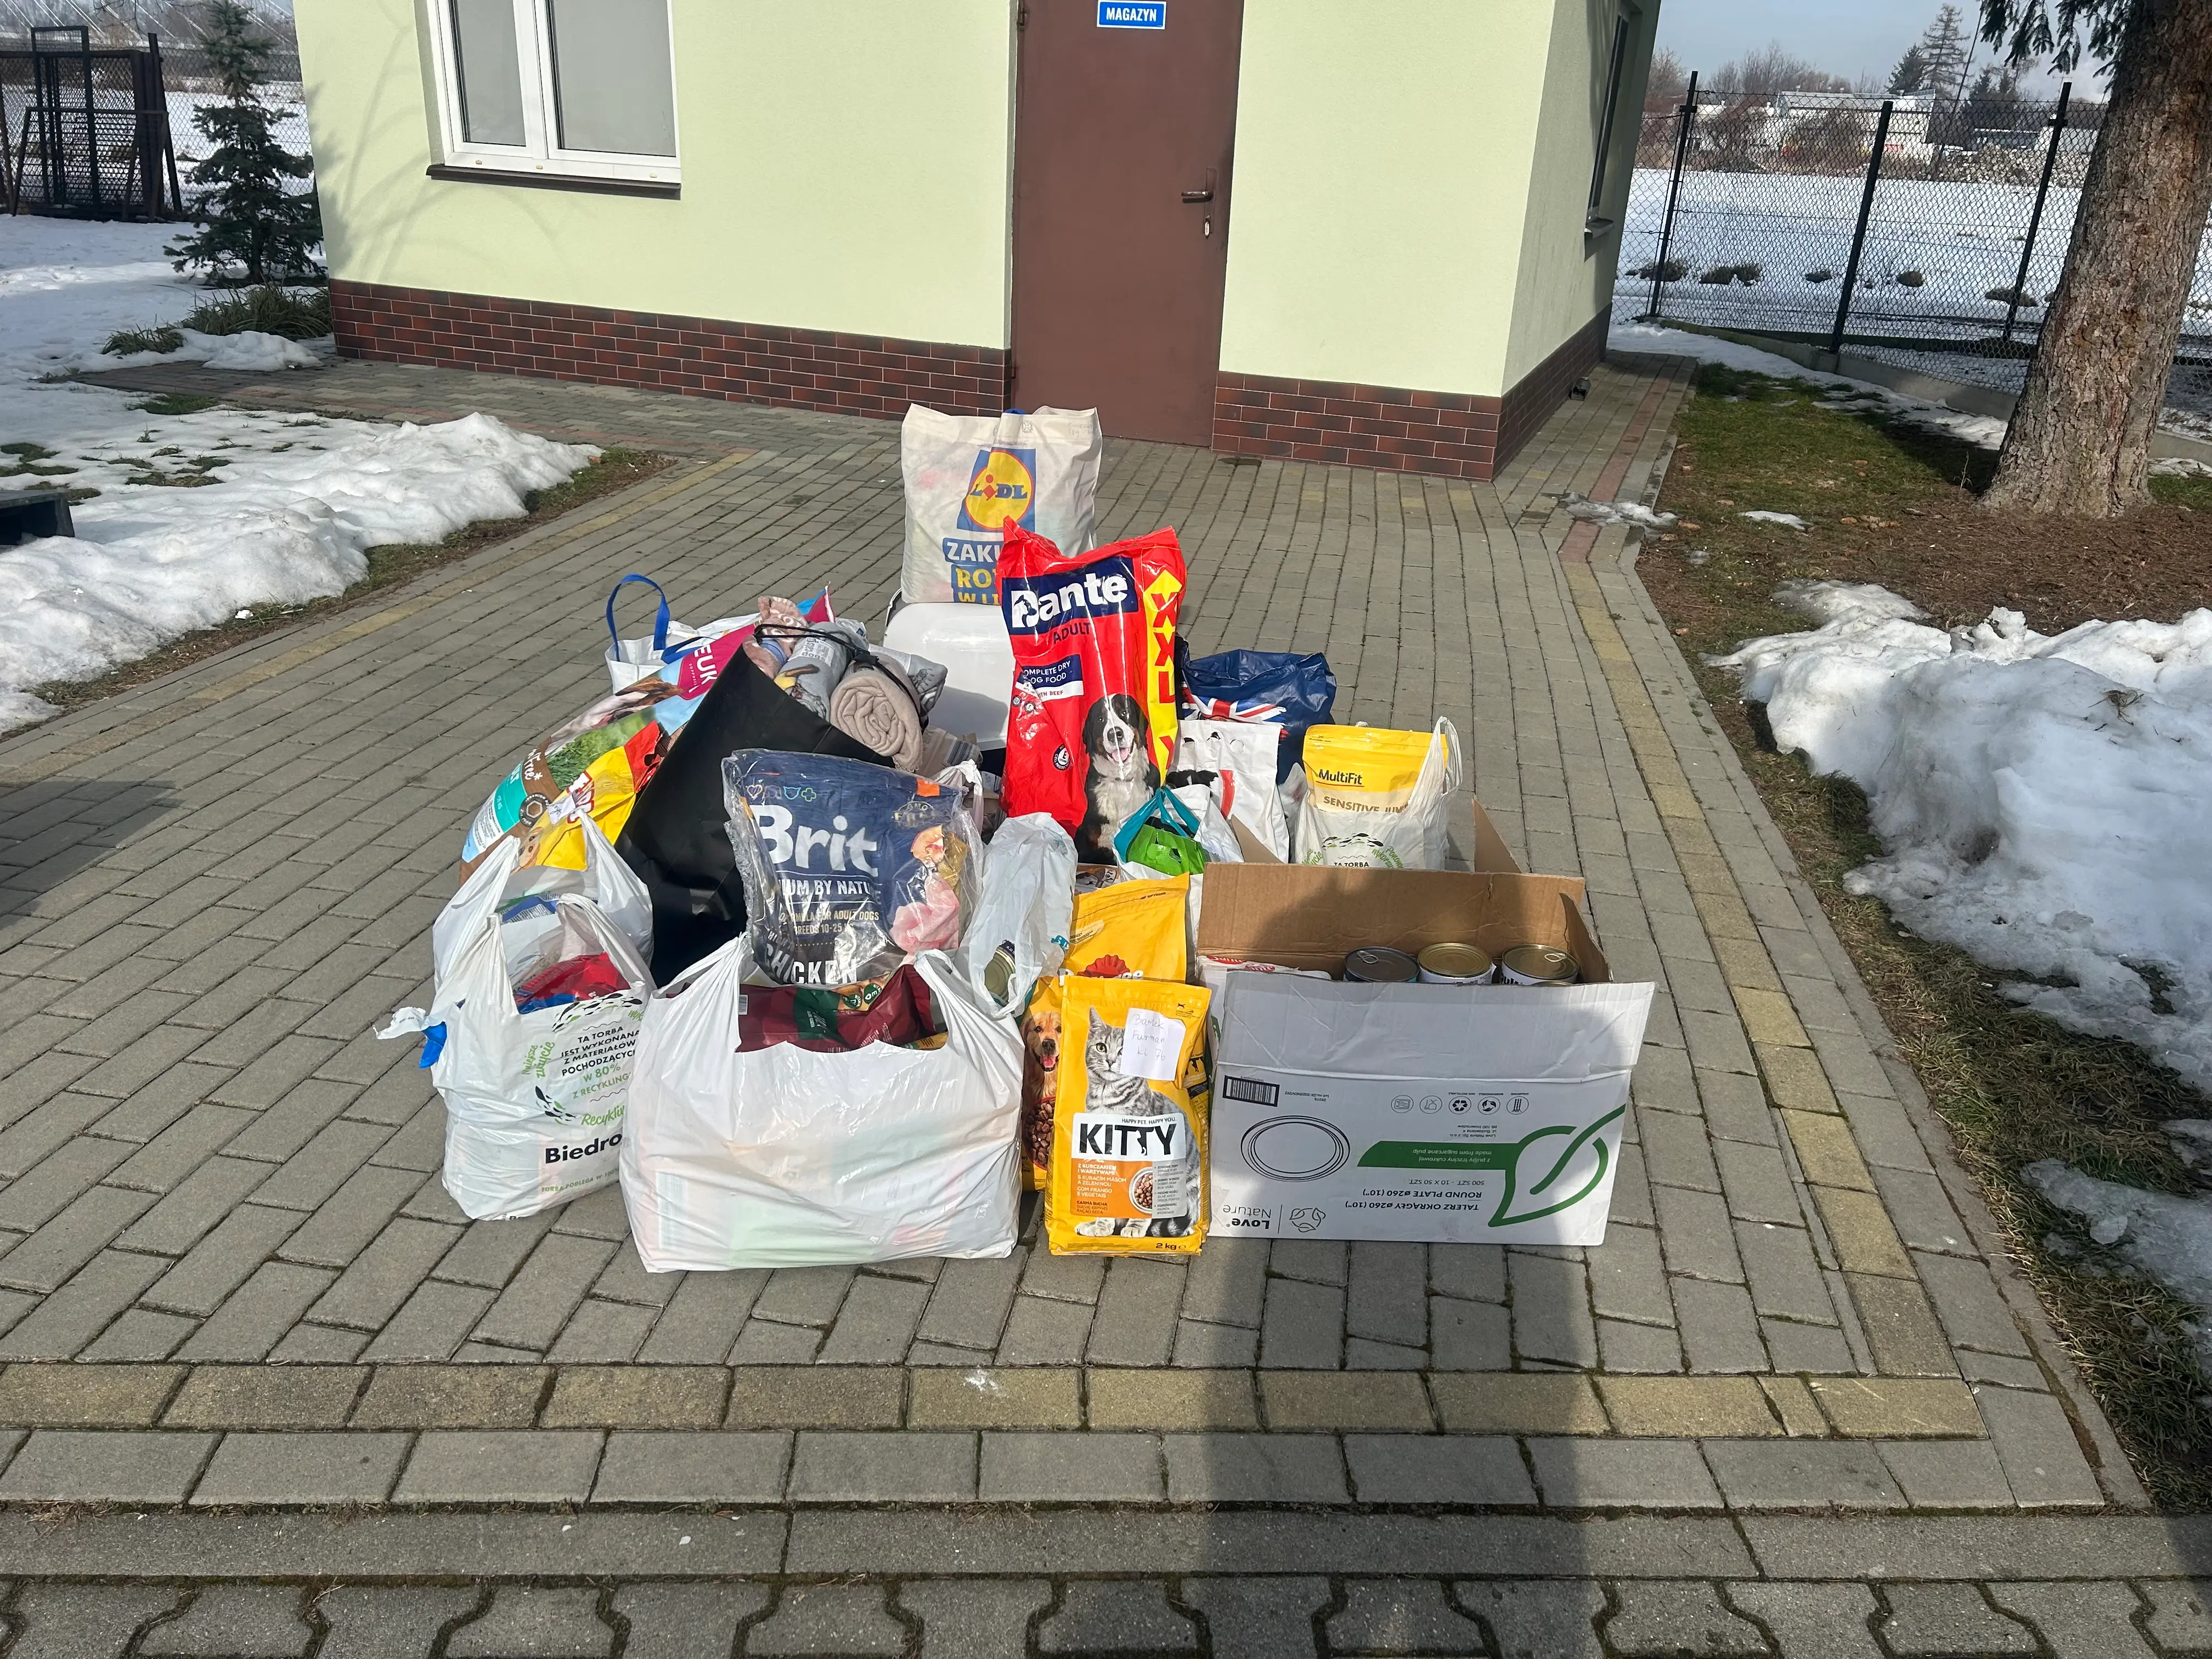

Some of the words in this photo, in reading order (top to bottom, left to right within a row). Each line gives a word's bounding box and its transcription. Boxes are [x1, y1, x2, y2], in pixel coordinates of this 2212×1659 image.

[1106, 7, 1157, 21] MAGAZYN
[1011, 573, 1128, 628] Dante
[1053, 622, 1091, 645] ADULT
[1024, 667, 1057, 676] OMPLETE
[1058, 661, 1071, 672] DRY
[1045, 673, 1066, 683] FOOD
[1318, 769, 1363, 785] MultiFit
[1323, 796, 1379, 812] SENSITIVE
[750, 805, 878, 878] Brit
[814, 879, 832, 895] BY
[837, 881, 871, 895] NATU
[859, 911, 879, 921] DOGS
[1133, 1014, 1164, 1029] Bartek
[592, 1026, 623, 1040] TORBA
[1132, 1030, 1165, 1044] Furman
[560, 1048, 580, 1058] JEST
[582, 1030, 640, 1052] WYKONANA
[572, 1039, 636, 1062] MATERIAŁÓW
[583, 1074, 592, 1082] W
[595, 1062, 621, 1079] 80%
[580, 1072, 631, 1097] RECYKLING
[1079, 1123, 1177, 1155] KITTY
[545, 1133, 623, 1164] Biedro
[565, 1178, 594, 1189] PODLEGA
[1223, 1205, 1272, 1218] Nature
[1395, 1201, 1441, 1210] OKRĄGŁY
[1232, 1218, 1270, 1229] Love
